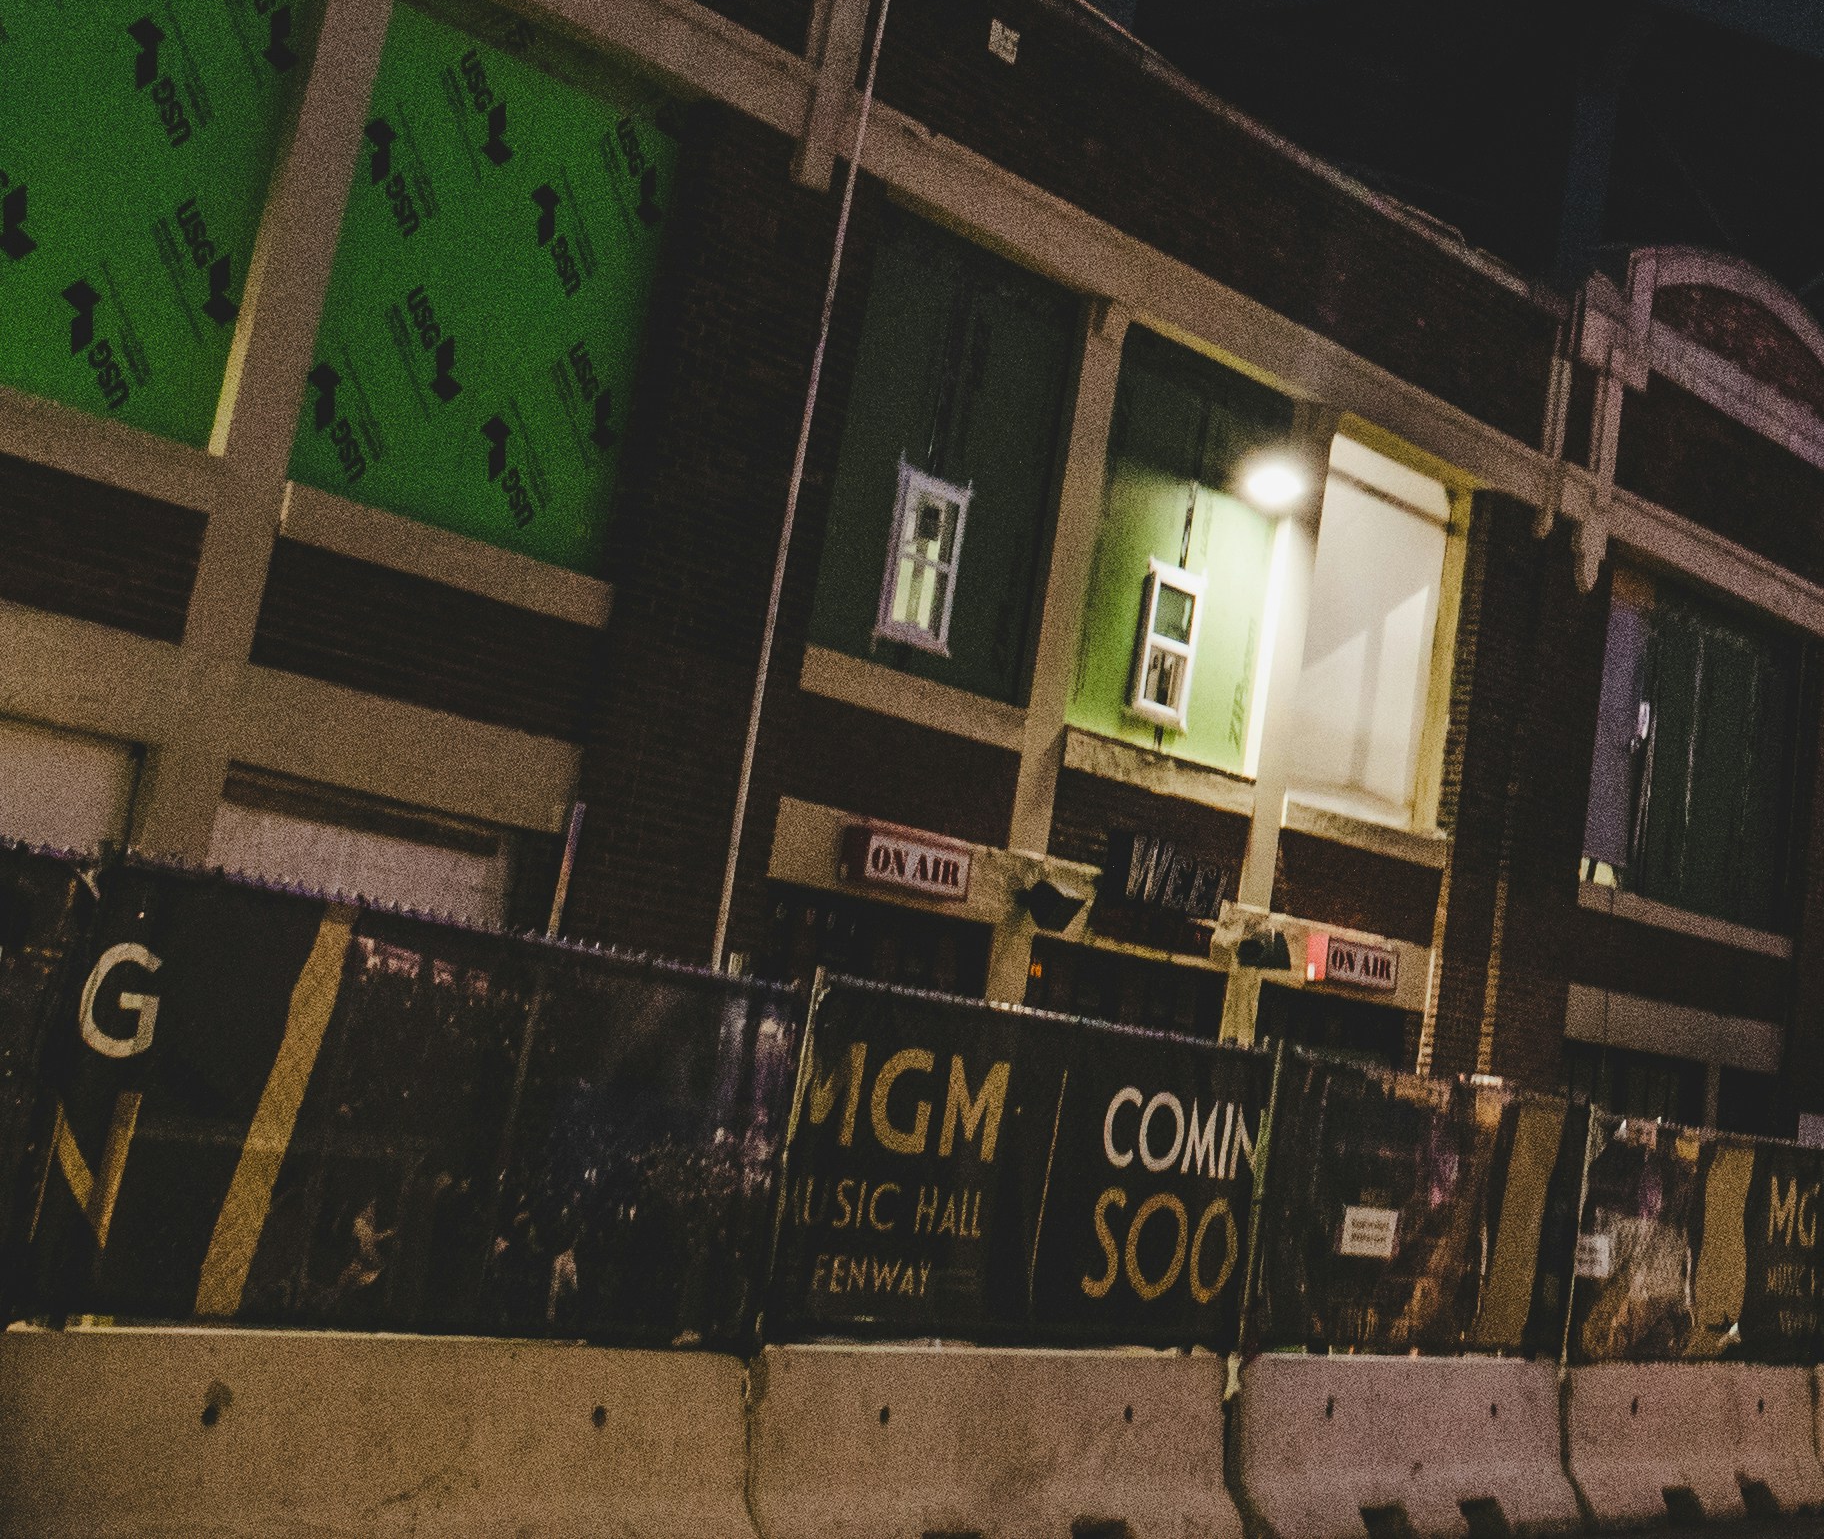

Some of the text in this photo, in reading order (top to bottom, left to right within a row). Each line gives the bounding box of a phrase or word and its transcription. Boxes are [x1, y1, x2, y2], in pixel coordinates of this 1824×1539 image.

[152, 77, 191, 147] USG
[461, 48, 494, 113] USG
[616, 117, 646, 178] USG
[176, 198, 216, 268] USG
[386, 173, 420, 237] USG
[550, 235, 582, 297] USG
[406, 285, 441, 351] USG
[87, 339, 130, 410] USG
[329, 418, 367, 483] USG
[501, 467, 534, 530] USG
[871, 845, 960, 887] ON AIR
[1331, 947, 1391, 981] ON AIR
[808, 1041, 1012, 1164] MGM
[913, 1185, 983, 1240] HALL
[811, 1253, 933, 1299] FENWAY
